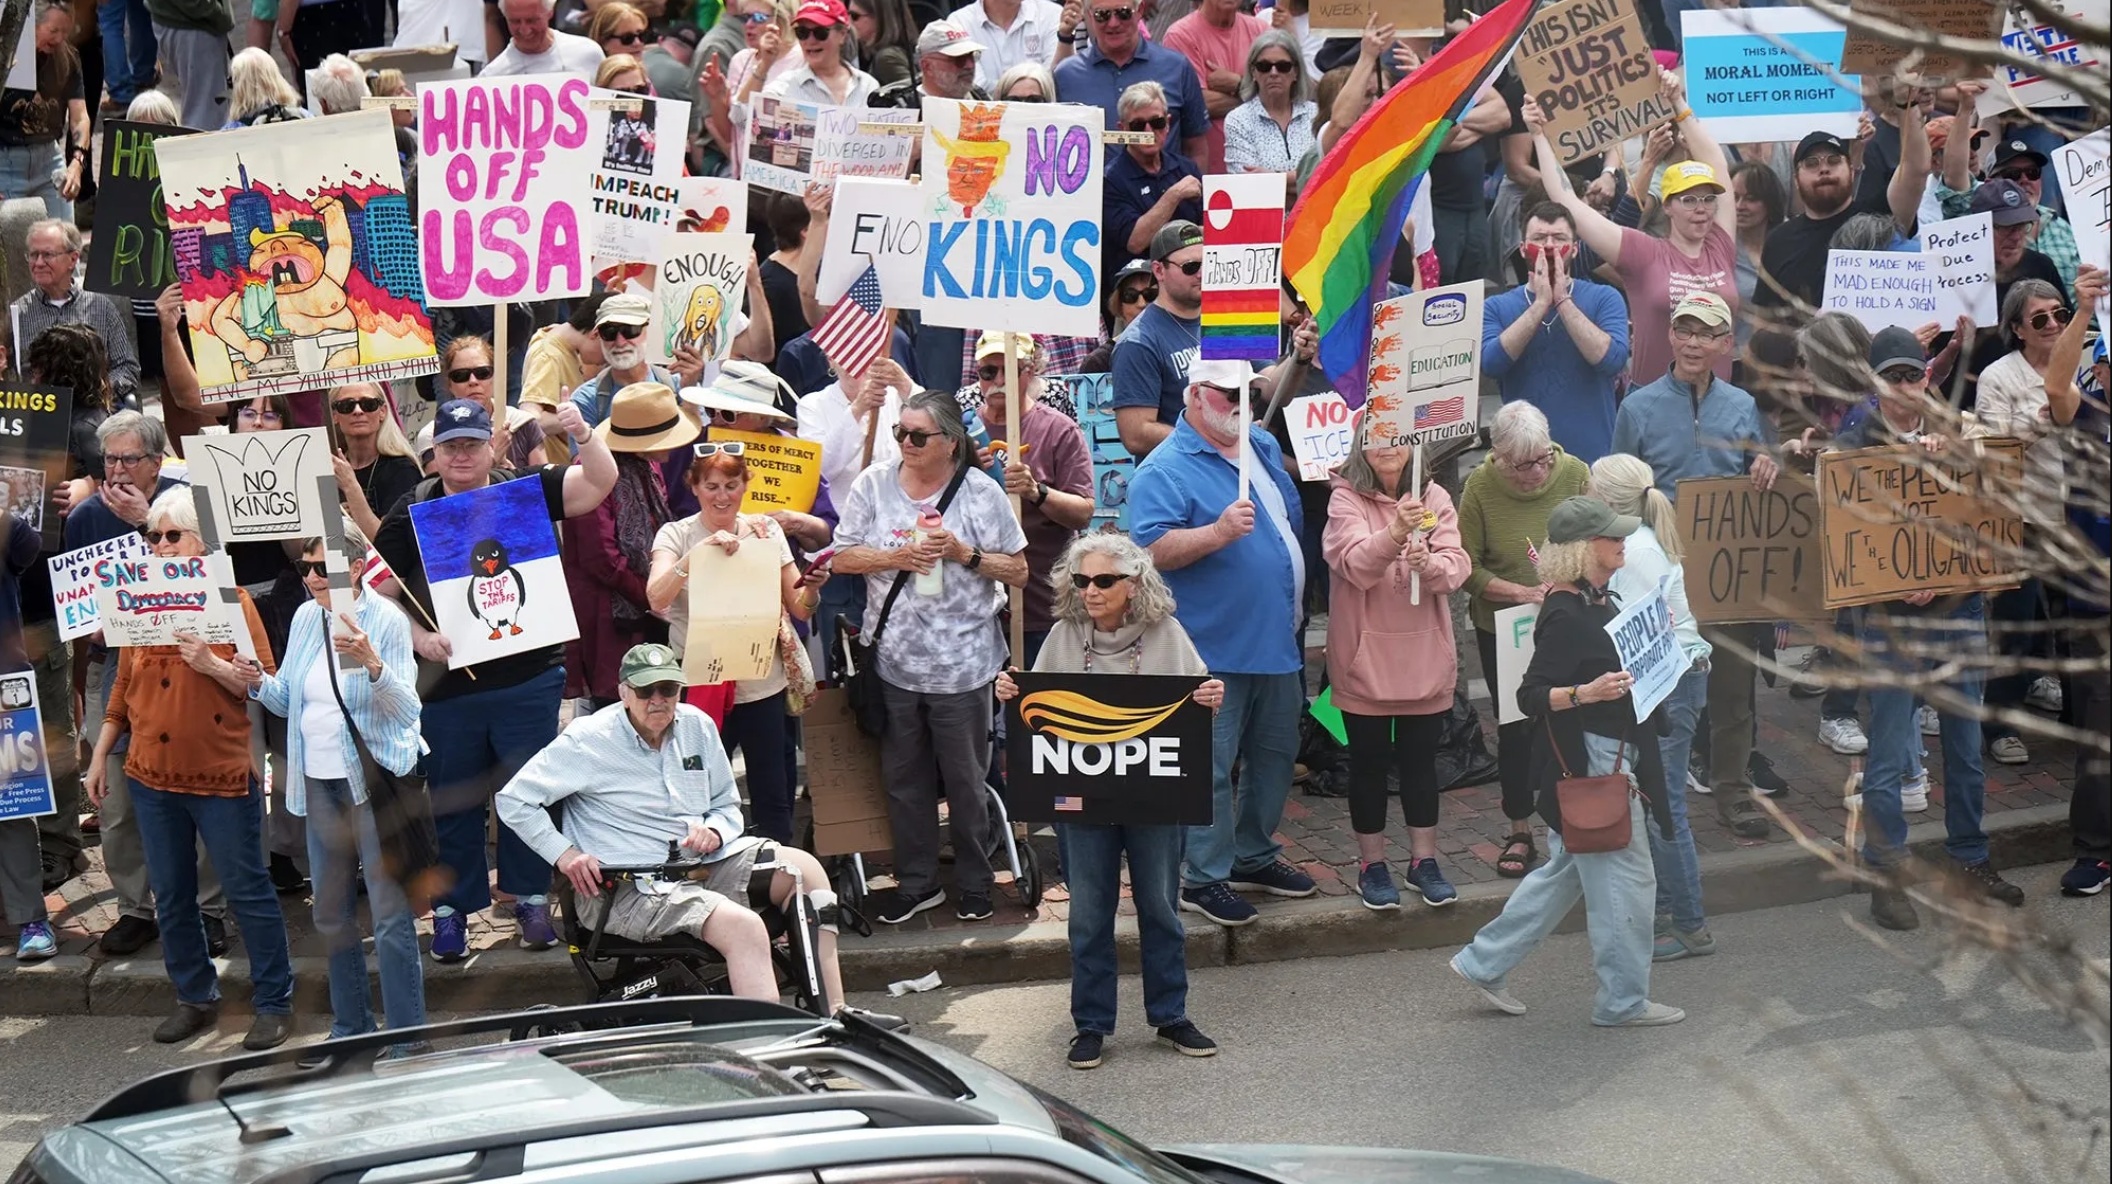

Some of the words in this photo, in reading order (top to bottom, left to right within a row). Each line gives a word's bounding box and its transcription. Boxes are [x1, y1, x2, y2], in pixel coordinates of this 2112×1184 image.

[1743, 48, 1766, 56] THIS
[1768, 48, 1778, 56] IS
[1780, 48, 1788, 56] A
[1704, 65, 1762, 80] MORAL
[1766, 62, 1834, 79] MOMENT
[1583, 93, 1621, 121] IT'S
[1706, 92, 1735, 104] NOT
[1738, 91, 1769, 103] LEFT
[1771, 90, 1792, 102] OR
[1795, 88, 1836, 100] RIGHT
[423, 79, 589, 157] HANDS
[820, 108, 857, 136] TWO
[1558, 93, 1672, 162] SURVIVAL
[817, 138, 887, 160] DIVERGED
[895, 142, 911, 157] IN
[1023, 124, 1092, 197] NO
[446, 150, 546, 202] OFF
[744, 162, 799, 191] AMERICA
[813, 160, 840, 181] THE
[878, 163, 906, 177] AND
[590, 173, 680, 204] IMPEACH
[592, 197, 670, 226] TRUMP!
[851, 213, 922, 255] ENO
[1928, 223, 1988, 250] Protect
[423, 201, 582, 301] USA
[922, 218, 1100, 307] KINGS
[1833, 255, 1862, 268] THIS
[1869, 258, 1902, 270] MADE
[1907, 260, 1926, 271] ME
[1942, 253, 1975, 268] Due
[664, 253, 745, 294] ENOUGH
[1243, 247, 1282, 285] OFF!
[1834, 274, 1867, 290] MAD
[1871, 276, 1932, 294] ENOUGH
[1426, 309, 1460, 322] Security
[1830, 295, 1848, 308] TO
[1855, 296, 1890, 309] HOLD
[1894, 298, 1904, 308] A
[1908, 297, 1936, 311] SIGN
[1410, 351, 1473, 375] EDUCATION
[201, 385, 247, 404] GIVE
[257, 377, 287, 393] ME
[298, 373, 338, 391] YOUR
[1306, 401, 1348, 429] NO
[1390, 421, 1476, 448] CONSTITUTION
[746, 458, 802, 475] TOGETHER
[769, 445, 782, 454] OF
[784, 448, 815, 461] MERCY
[243, 470, 277, 493] NO
[764, 476, 781, 487] WE
[1831, 466, 1873, 509] WE
[1874, 467, 1900, 490] THE
[232, 491, 297, 518] KINGS
[1693, 490, 1814, 541] HANDS
[1893, 500, 1942, 525] NOT
[52, 534, 141, 573] UNCHECKE
[1826, 530, 1865, 589] WE
[94, 560, 149, 588] SAVE
[163, 557, 207, 579] OUR
[478, 576, 509, 595] STOP
[1709, 546, 1803, 603] OFF!
[482, 592, 516, 610] TARIFFS
[487, 588, 504, 600] THE
[111, 615, 145, 628] HANDS
[1613, 604, 1661, 664] PEOPLE
[1032, 735, 1181, 777] NOPE
[8, 790, 25, 798] Free
[25, 787, 45, 796] Press
[14, 795, 42, 805] Process
[621, 976, 658, 999] Jazzy
